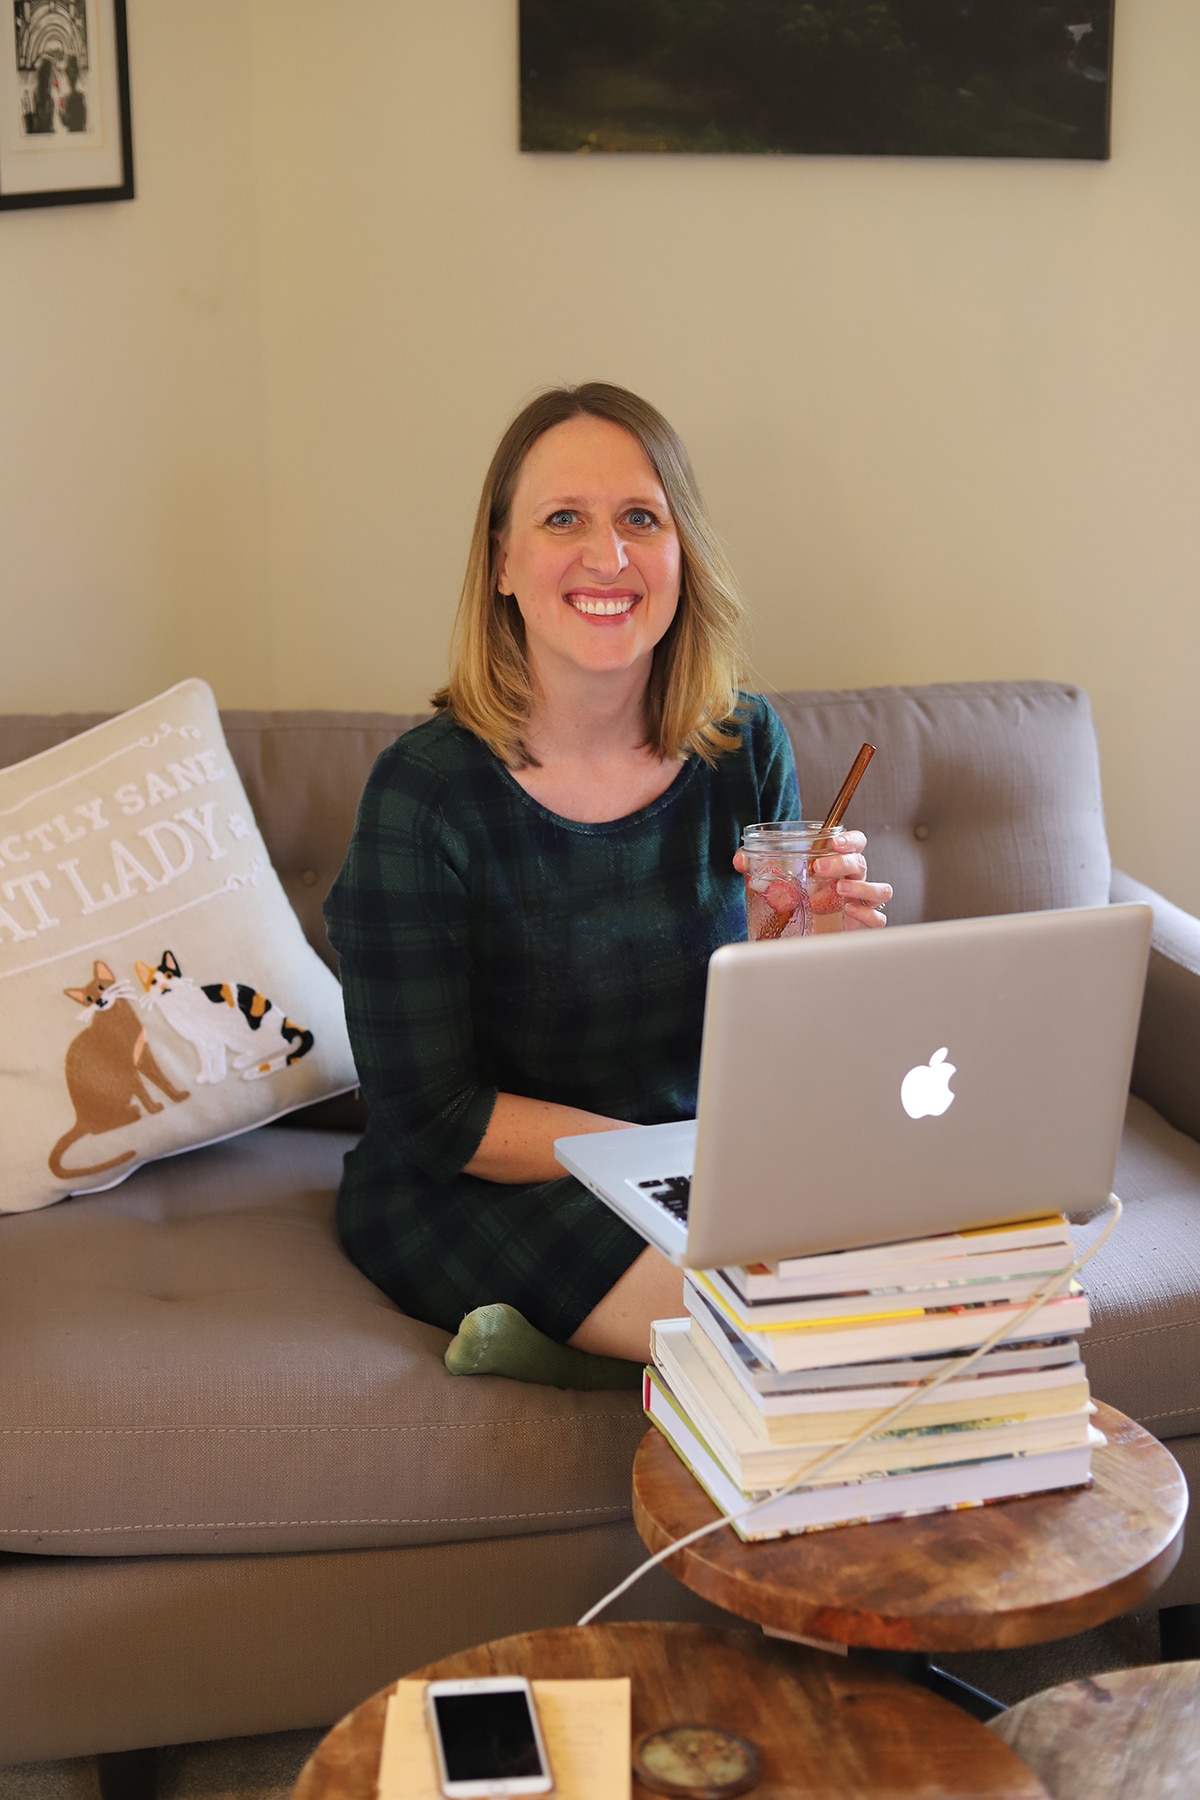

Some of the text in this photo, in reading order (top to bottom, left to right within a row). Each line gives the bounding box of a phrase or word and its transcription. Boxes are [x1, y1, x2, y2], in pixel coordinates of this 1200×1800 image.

[0, 749, 226, 868] CTLY SANE
[57, 802, 228, 915] LADY
